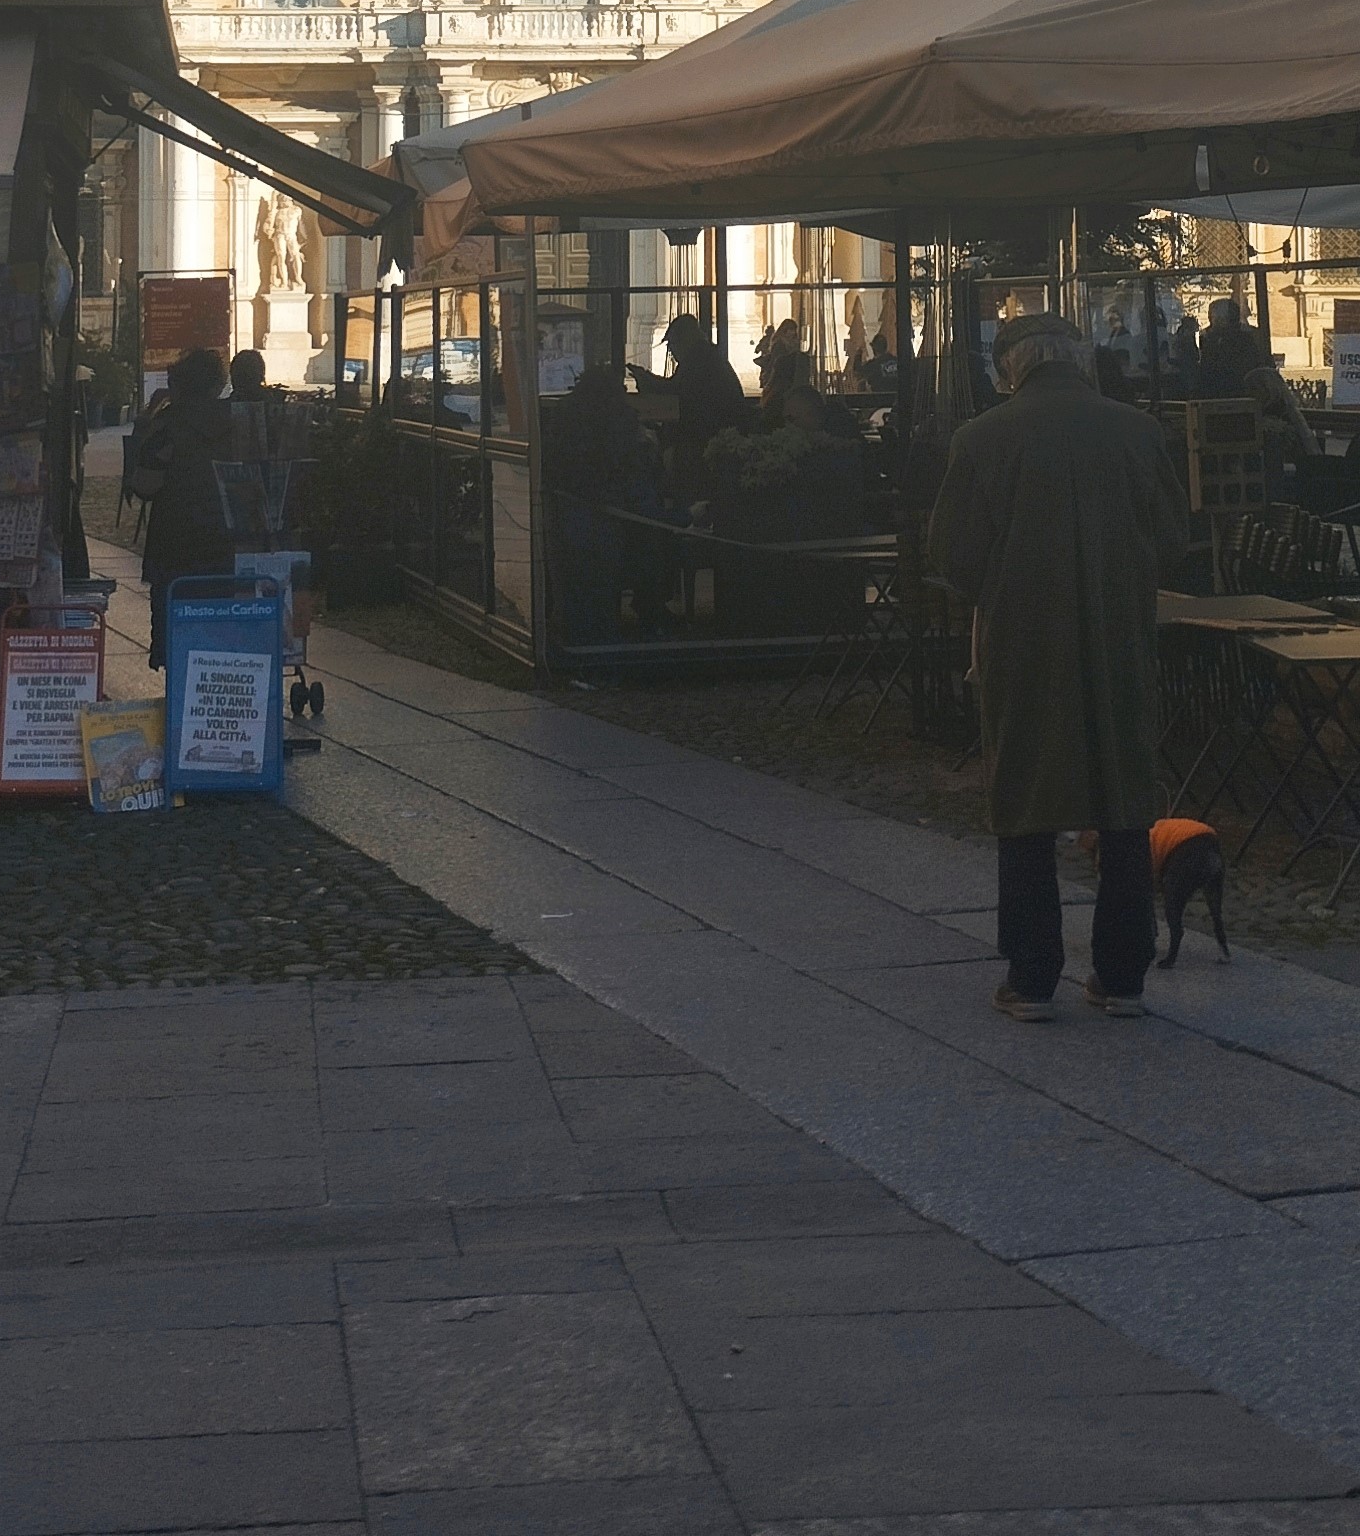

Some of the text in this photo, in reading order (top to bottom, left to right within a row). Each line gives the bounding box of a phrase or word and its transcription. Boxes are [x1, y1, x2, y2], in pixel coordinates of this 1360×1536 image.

[184, 606, 215, 617] Resto
[216, 607, 230, 616] del
[231, 603, 272, 615] Carlino
[9, 636, 94, 647] GAZZETTA DI MODENA
[198, 657, 220, 667] Resto
[234, 659, 264, 668] Carlino
[17, 676, 86, 686] UN MESE IN COMA
[200, 672, 254, 685] IL SINDACO
[27, 689, 76, 698] SI RISVEGLIA
[196, 683, 256, 696] MUZZARELLI:
[12, 701, 17, 710] E
[20, 701, 42, 710] VIENE
[216, 696, 226, 707] 10
[228, 696, 252, 707] ANNI
[26, 713, 74, 722] PER RAPINA
[190, 706, 259, 719] HO CAMBIATO
[206, 719, 238, 729] VOLTO
[193, 730, 216, 740] ALLA
